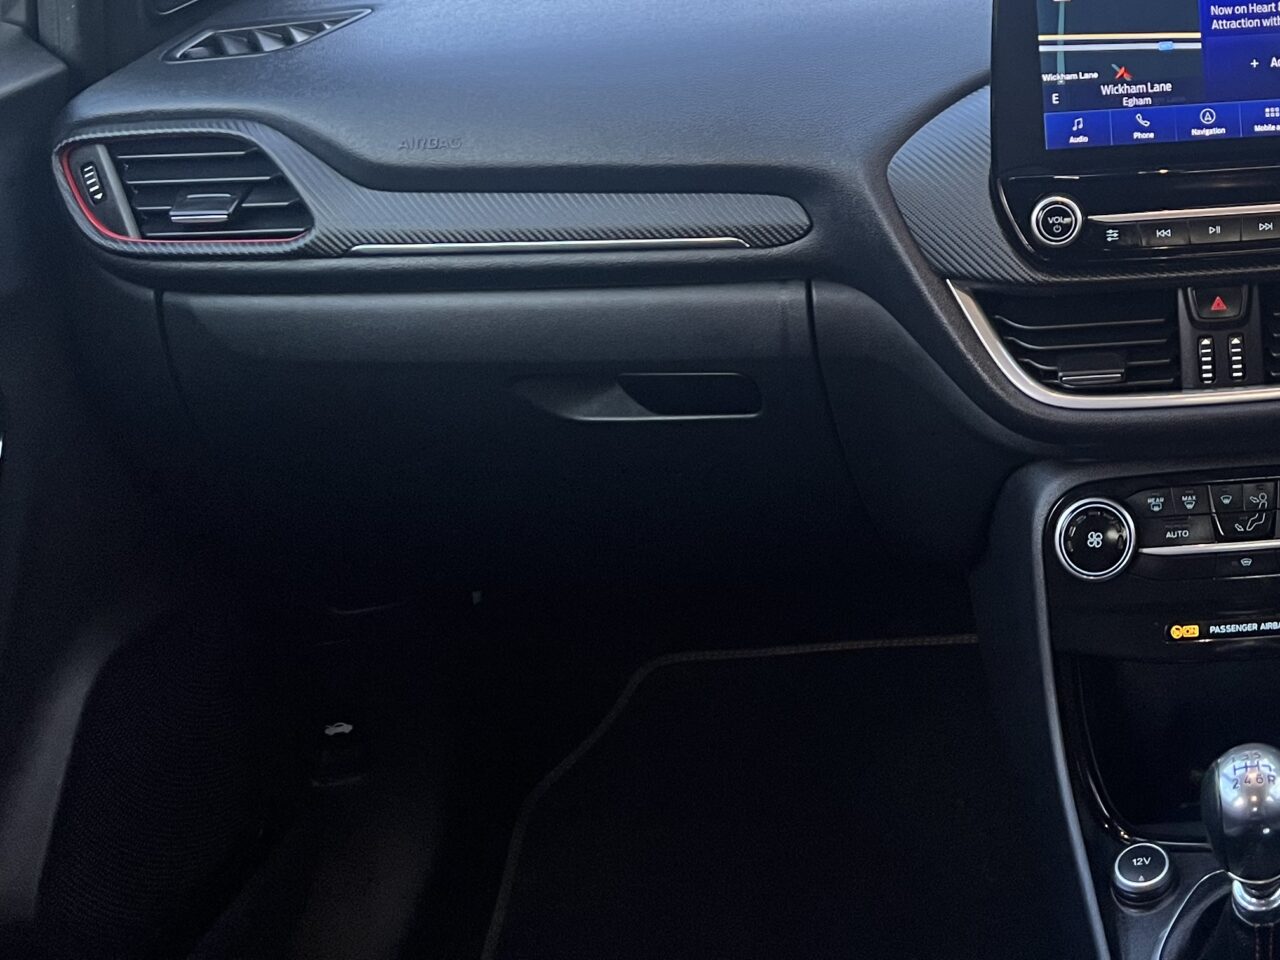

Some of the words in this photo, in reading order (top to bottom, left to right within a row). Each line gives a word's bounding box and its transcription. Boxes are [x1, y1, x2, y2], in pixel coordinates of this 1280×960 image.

[1210, 5, 1233, 16] Now
[1234, 5, 1248, 15] on
[1249, 2, 1276, 14] Heart
[1211, 17, 1260, 30] Attraction
[1042, 72, 1078, 82] Wickham
[1079, 71, 1099, 80] Lane
[1100, 83, 1147, 96] Wickham
[1148, 82, 1172, 93] Lane
[1051, 93, 1060, 104] E
[1122, 97, 1152, 108] Egham
[1191, 127, 1226, 136] Navigation
[1254, 123, 1275, 132] Mobile
[1069, 135, 1089, 144] Audio
[1133, 132, 1155, 140] Phone
[398, 136, 463, 150] AIRBAG
[1047, 216, 1066, 224] VOL
[1165, 529, 1189, 539] AUTO
[1209, 623, 1258, 634] PASSENGER
[1131, 856, 1151, 867] 12V
